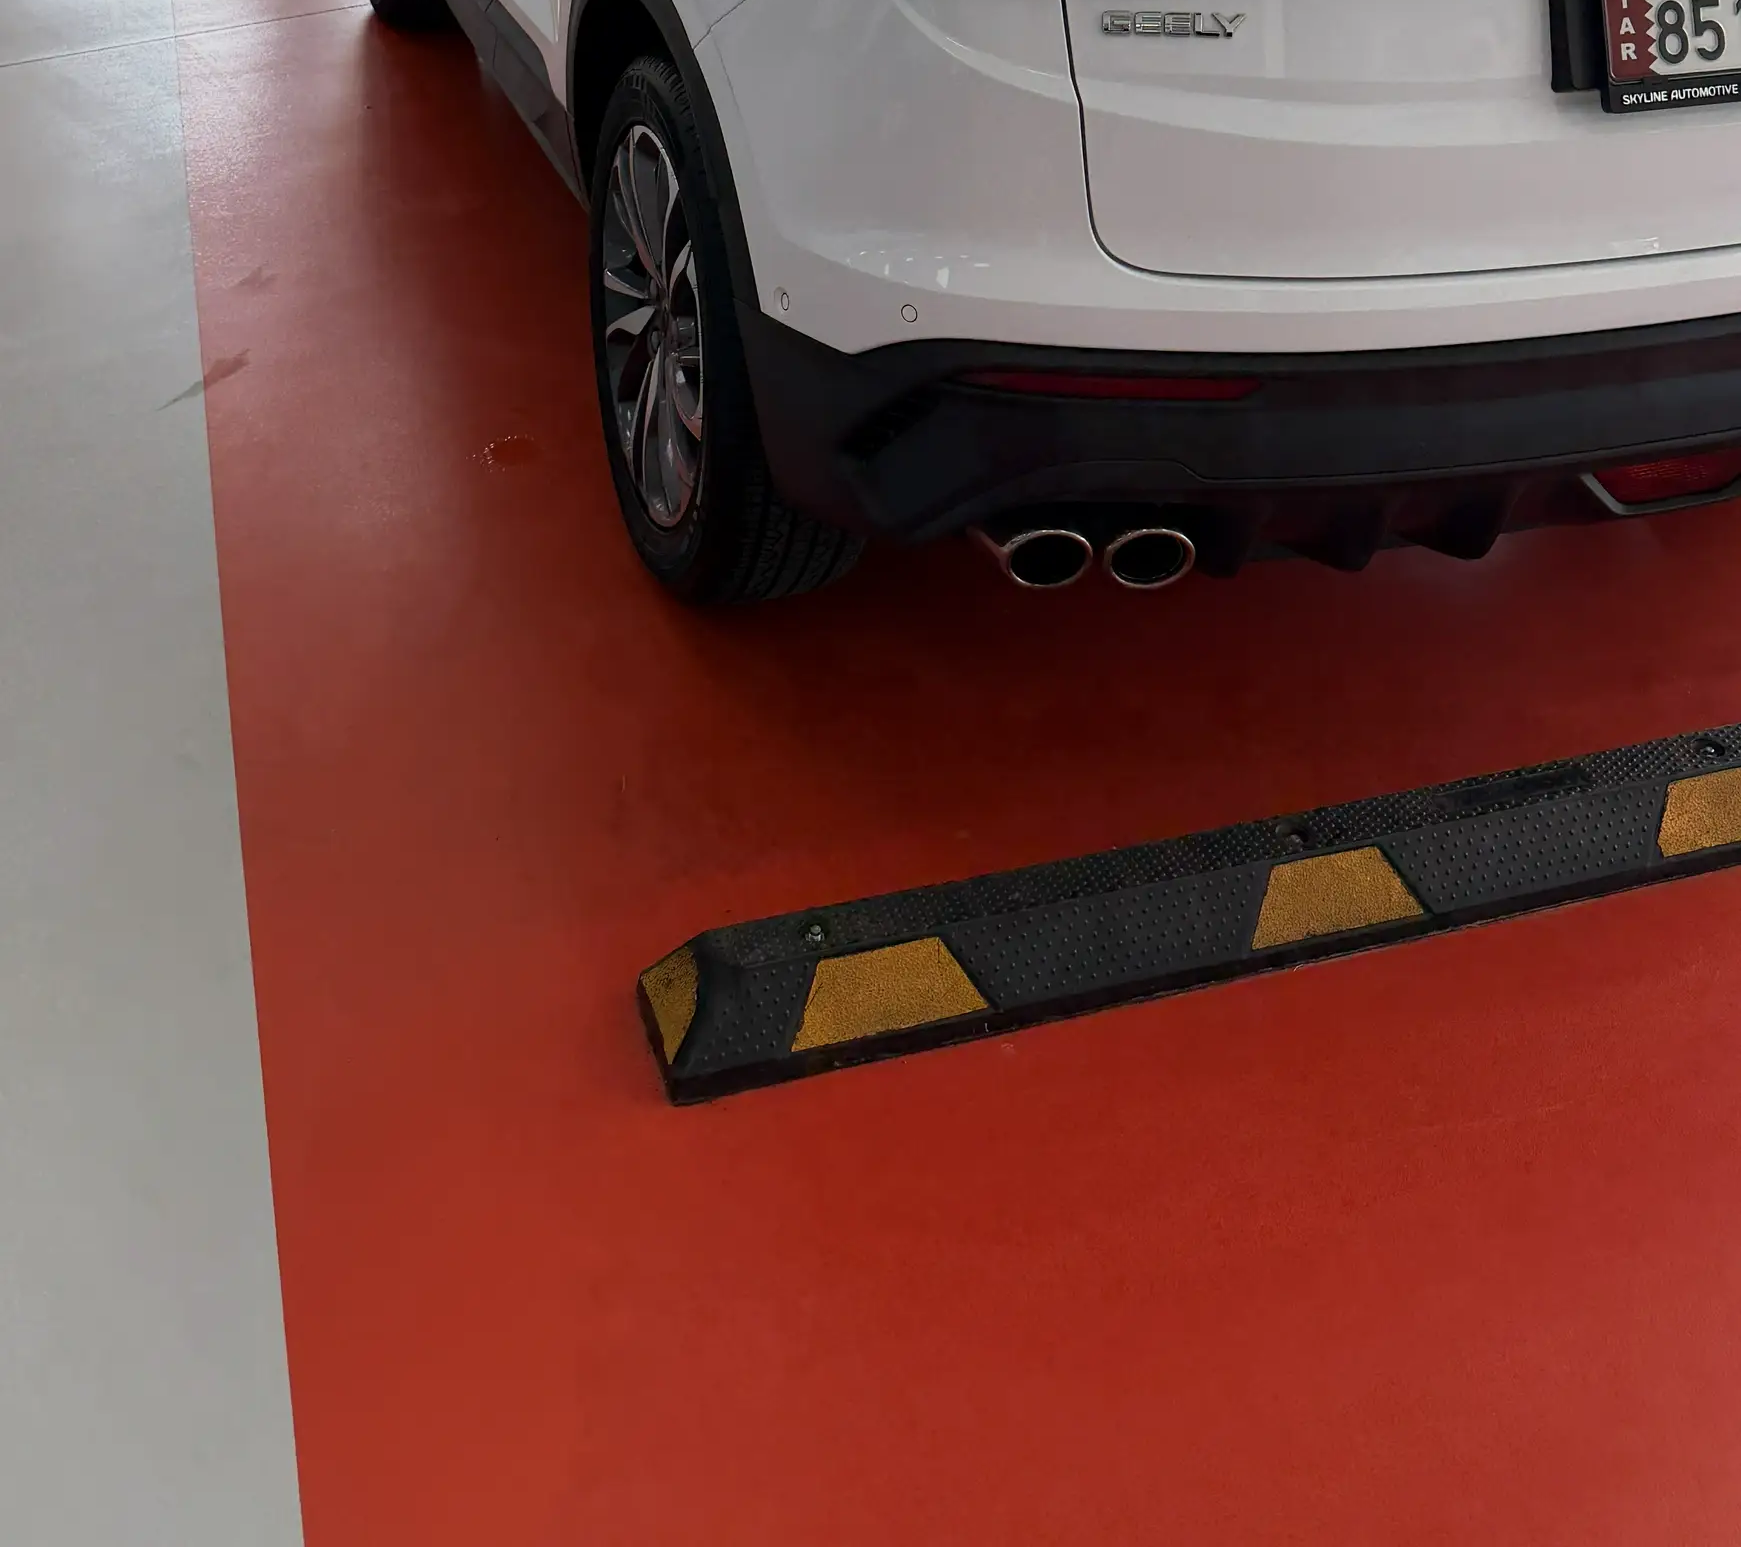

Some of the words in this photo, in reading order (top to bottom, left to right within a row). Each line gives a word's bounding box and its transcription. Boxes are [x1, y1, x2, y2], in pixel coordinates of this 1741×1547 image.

[1102, 10, 1247, 38] GEELY
[1622, 90, 1668, 106] SKYLINE
[1670, 83, 1739, 101] AUTOMOTIVE
